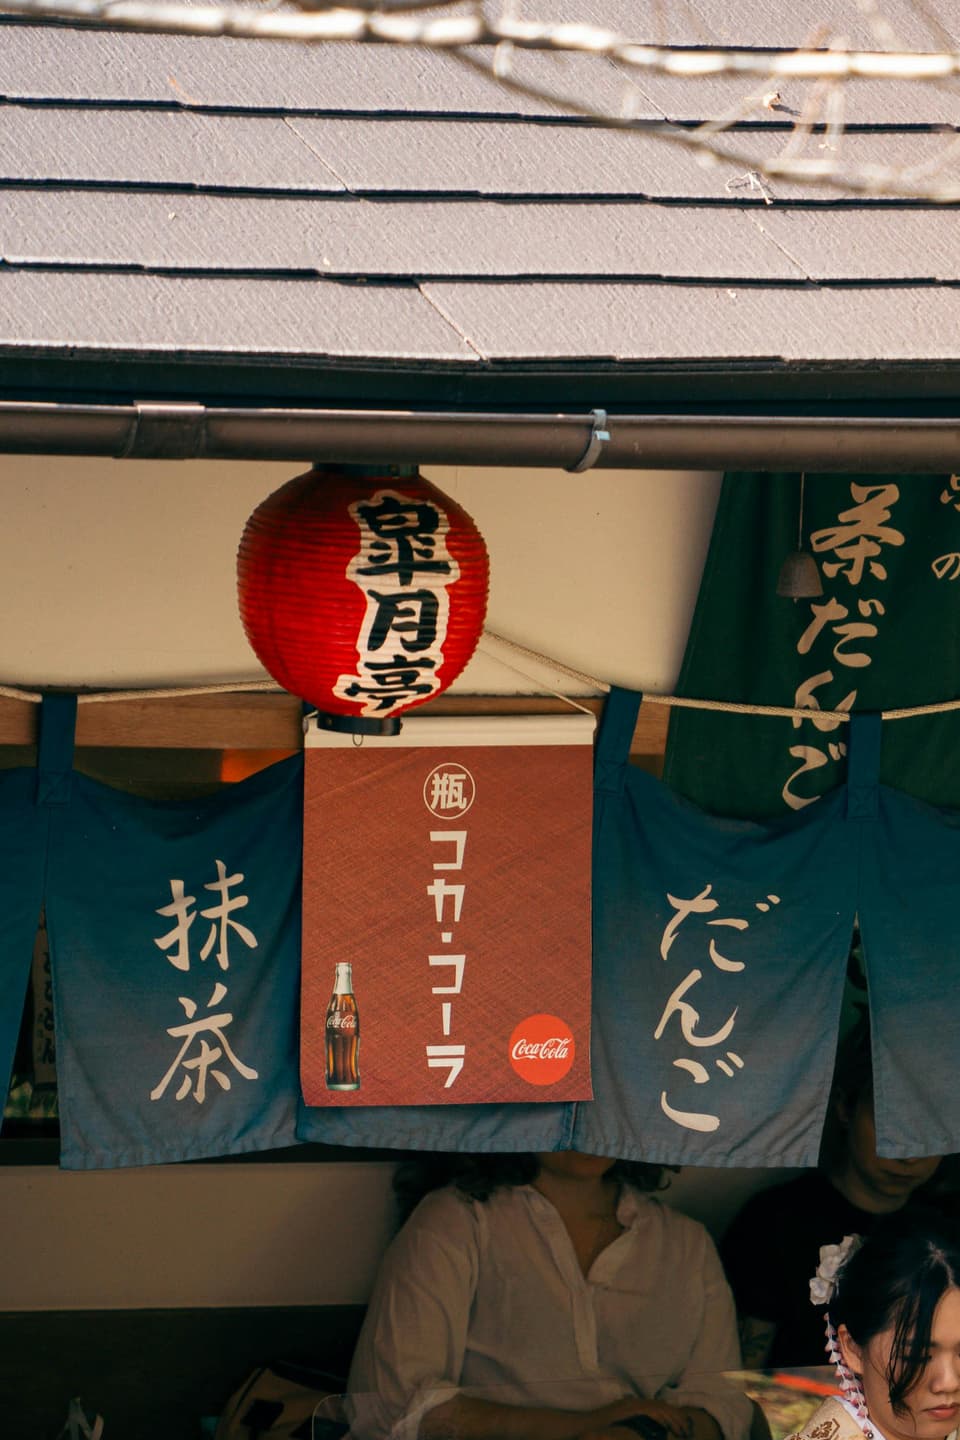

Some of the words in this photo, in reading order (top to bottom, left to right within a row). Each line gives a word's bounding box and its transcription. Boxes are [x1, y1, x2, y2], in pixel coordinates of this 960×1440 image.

[344, 496, 452, 711] 皐月亭
[782, 482, 905, 810] 茶だんご
[428, 770, 470, 812] 瓶
[150, 859, 258, 1104] 抹茶
[426, 831, 467, 1088] コカ・コーラ
[654, 884, 780, 1131] だんご
